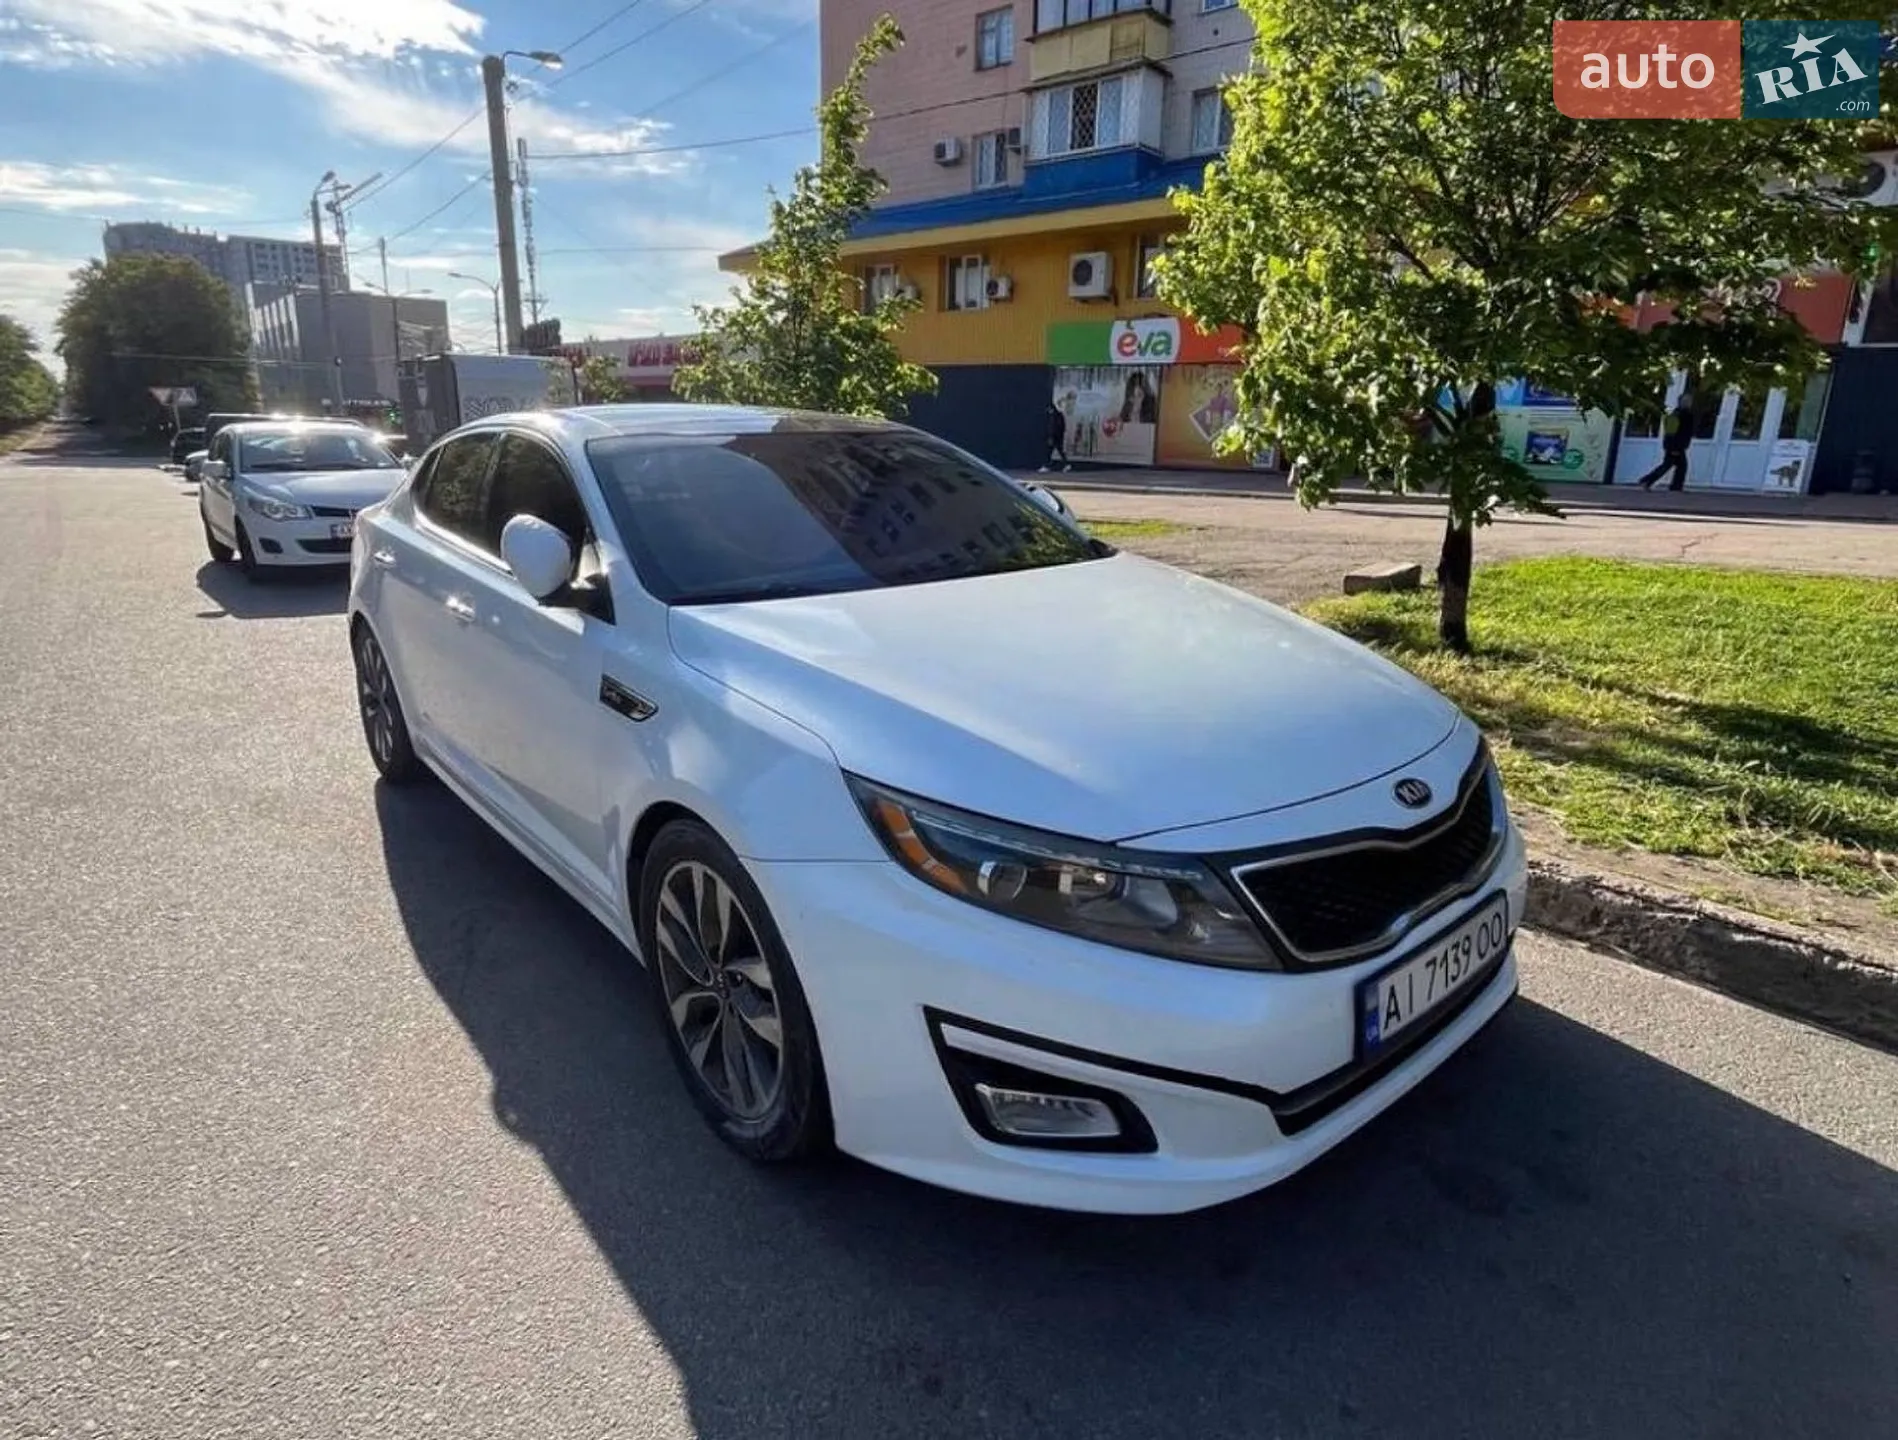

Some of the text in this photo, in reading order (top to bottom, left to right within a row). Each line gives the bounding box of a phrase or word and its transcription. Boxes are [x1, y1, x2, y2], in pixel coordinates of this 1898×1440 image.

[1117, 328, 1172, 357] eva
[1383, 973, 1414, 1030] AI
[1424, 935, 1472, 1001] 7139
